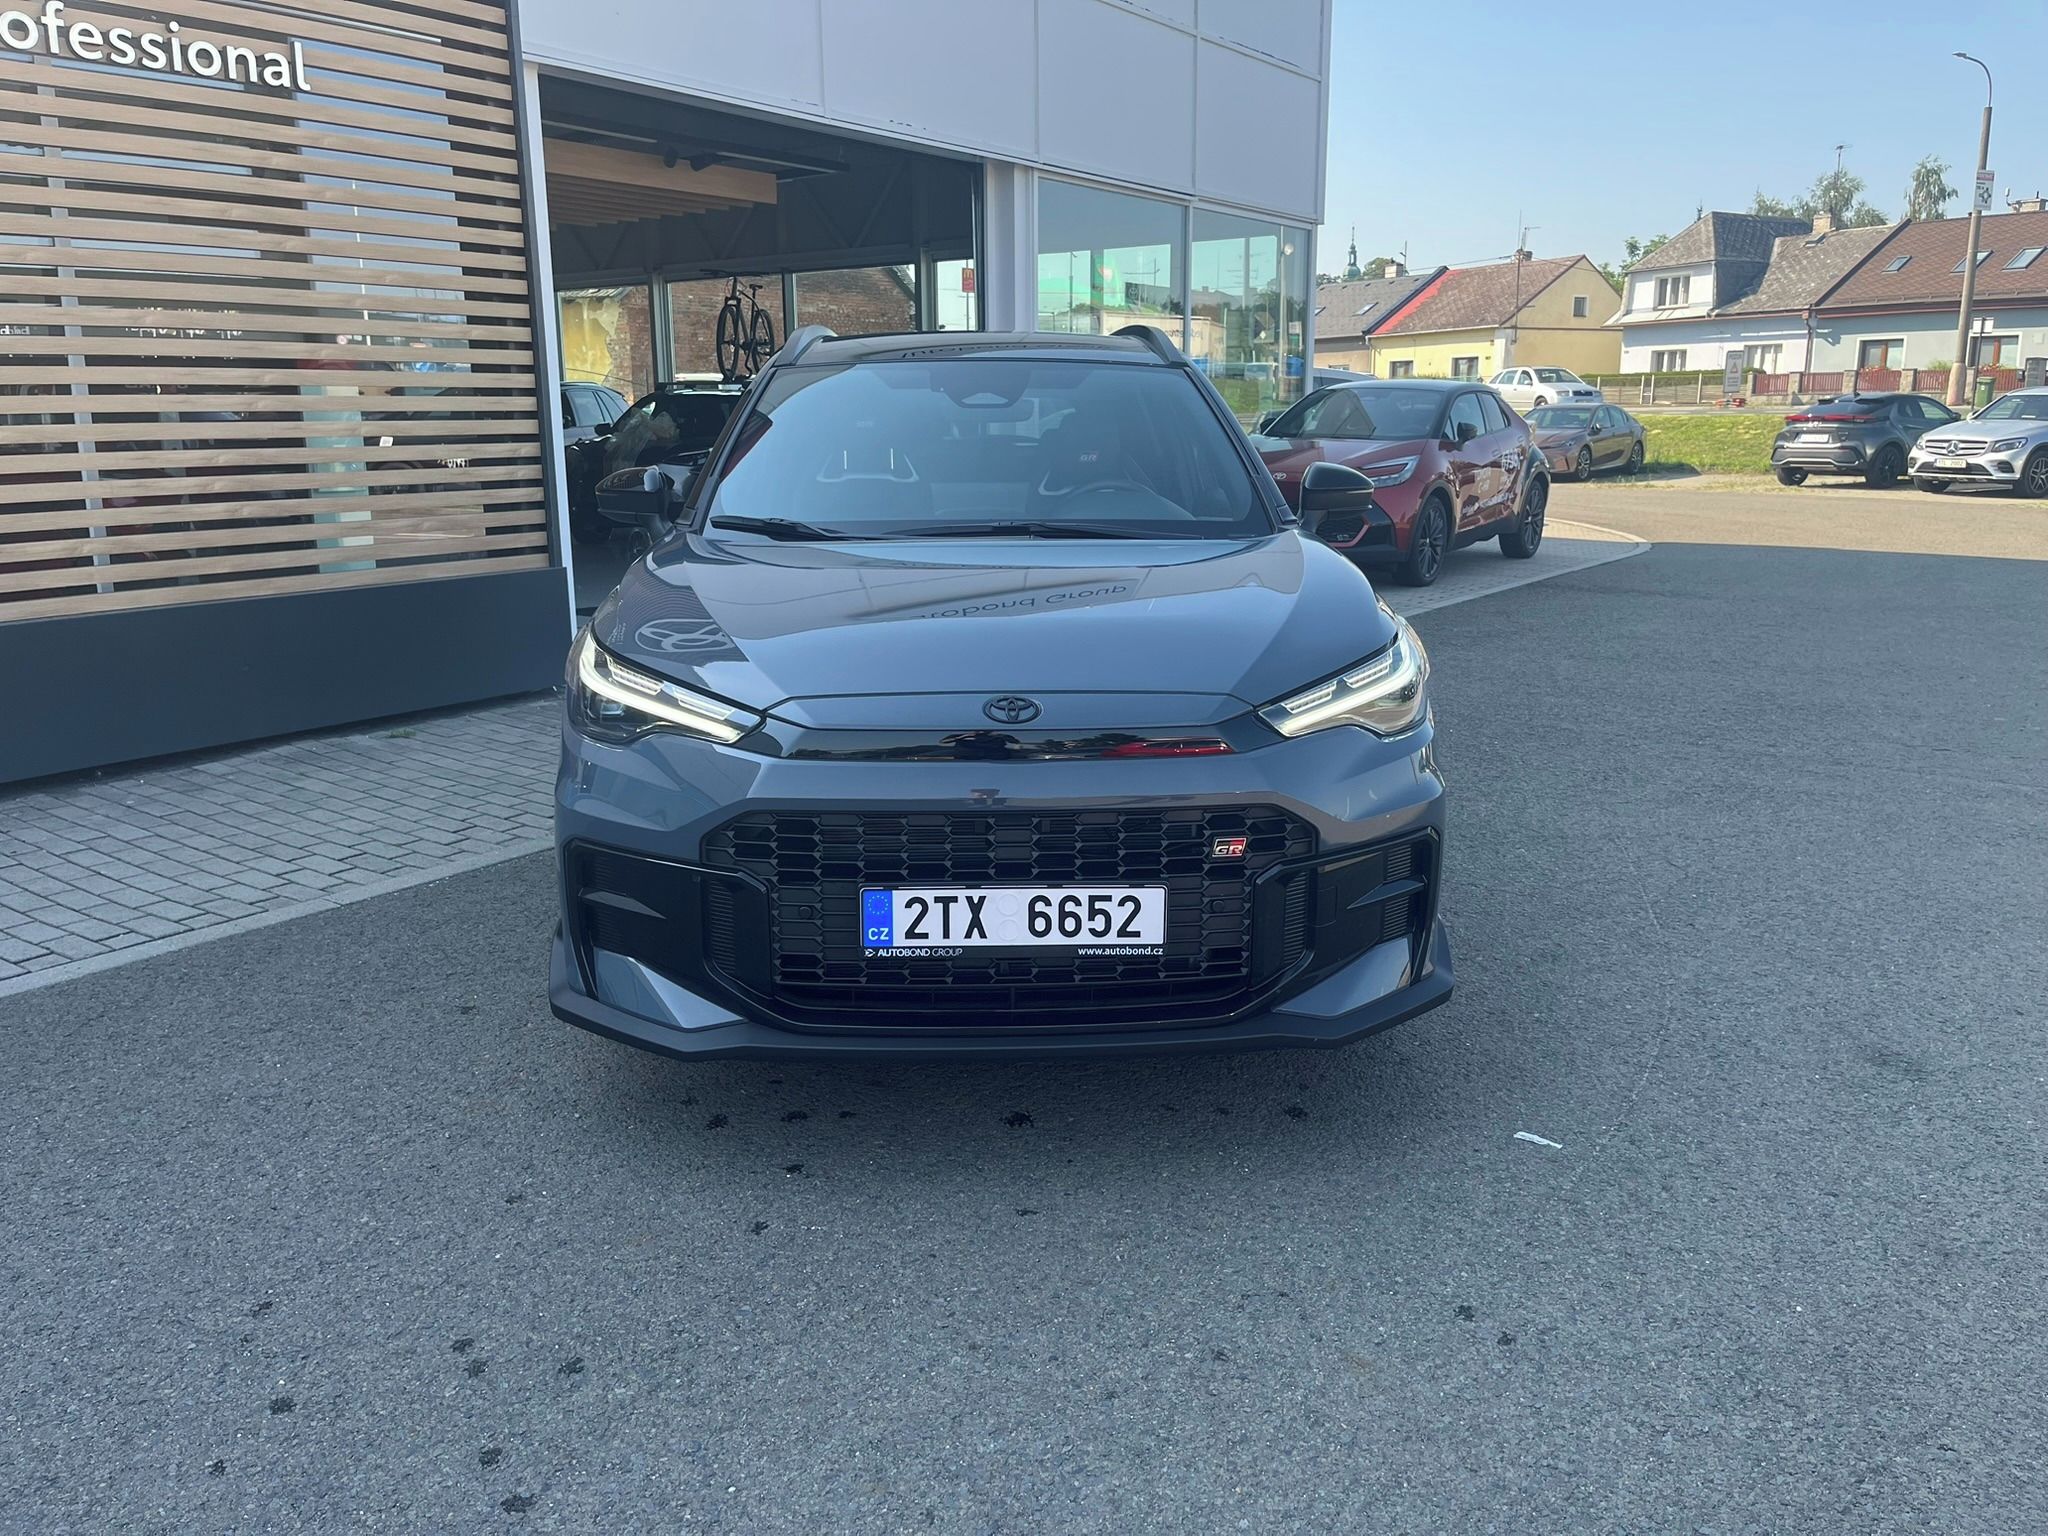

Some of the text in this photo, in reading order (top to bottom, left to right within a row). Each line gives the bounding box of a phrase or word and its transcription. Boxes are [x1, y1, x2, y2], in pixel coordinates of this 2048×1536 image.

[0, 0, 311, 91] ofessional
[1214, 845, 1243, 855] GR
[904, 894, 1142, 940] 2TX 6652
[868, 927, 889, 941] CZ
[877, 948, 963, 957] AUTOBOND GROUP
[1077, 946, 1164, 956] www.autobond.cz
